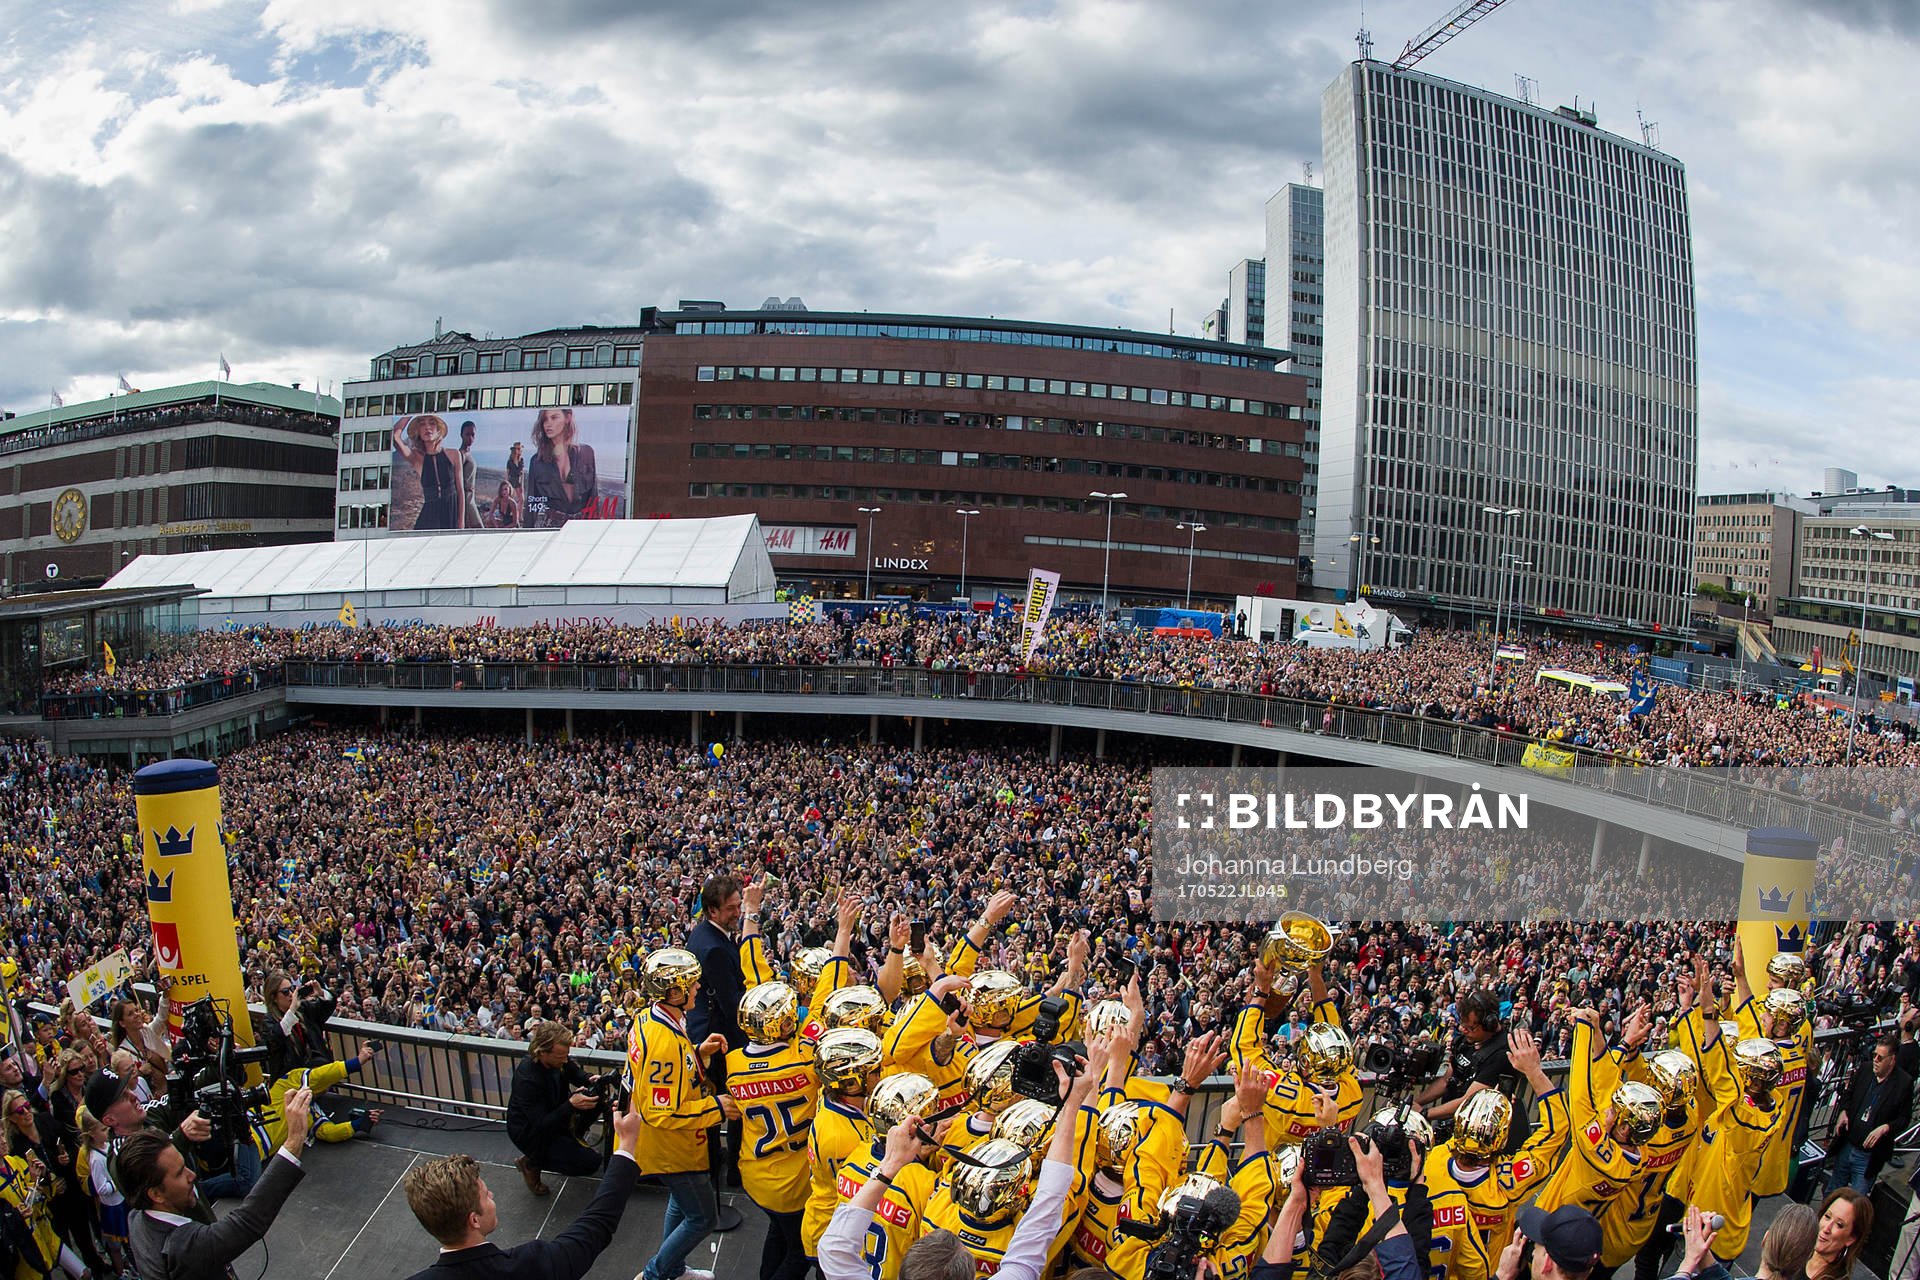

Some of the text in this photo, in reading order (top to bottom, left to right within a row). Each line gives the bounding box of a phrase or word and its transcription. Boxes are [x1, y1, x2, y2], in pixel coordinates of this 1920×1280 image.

[765, 529, 796, 549] H&M
[819, 529, 851, 550] H&M
[875, 557, 929, 571] LINDEX
[1027, 577, 1049, 624] SPORT
[1373, 589, 1406, 599] MANGO
[181, 974, 210, 986] SPEL
[649, 1060, 674, 1084] 22
[731, 1074, 809, 1099] BAUHAUS
[745, 1095, 814, 1159] 25
[959, 1230, 986, 1245] CCM
